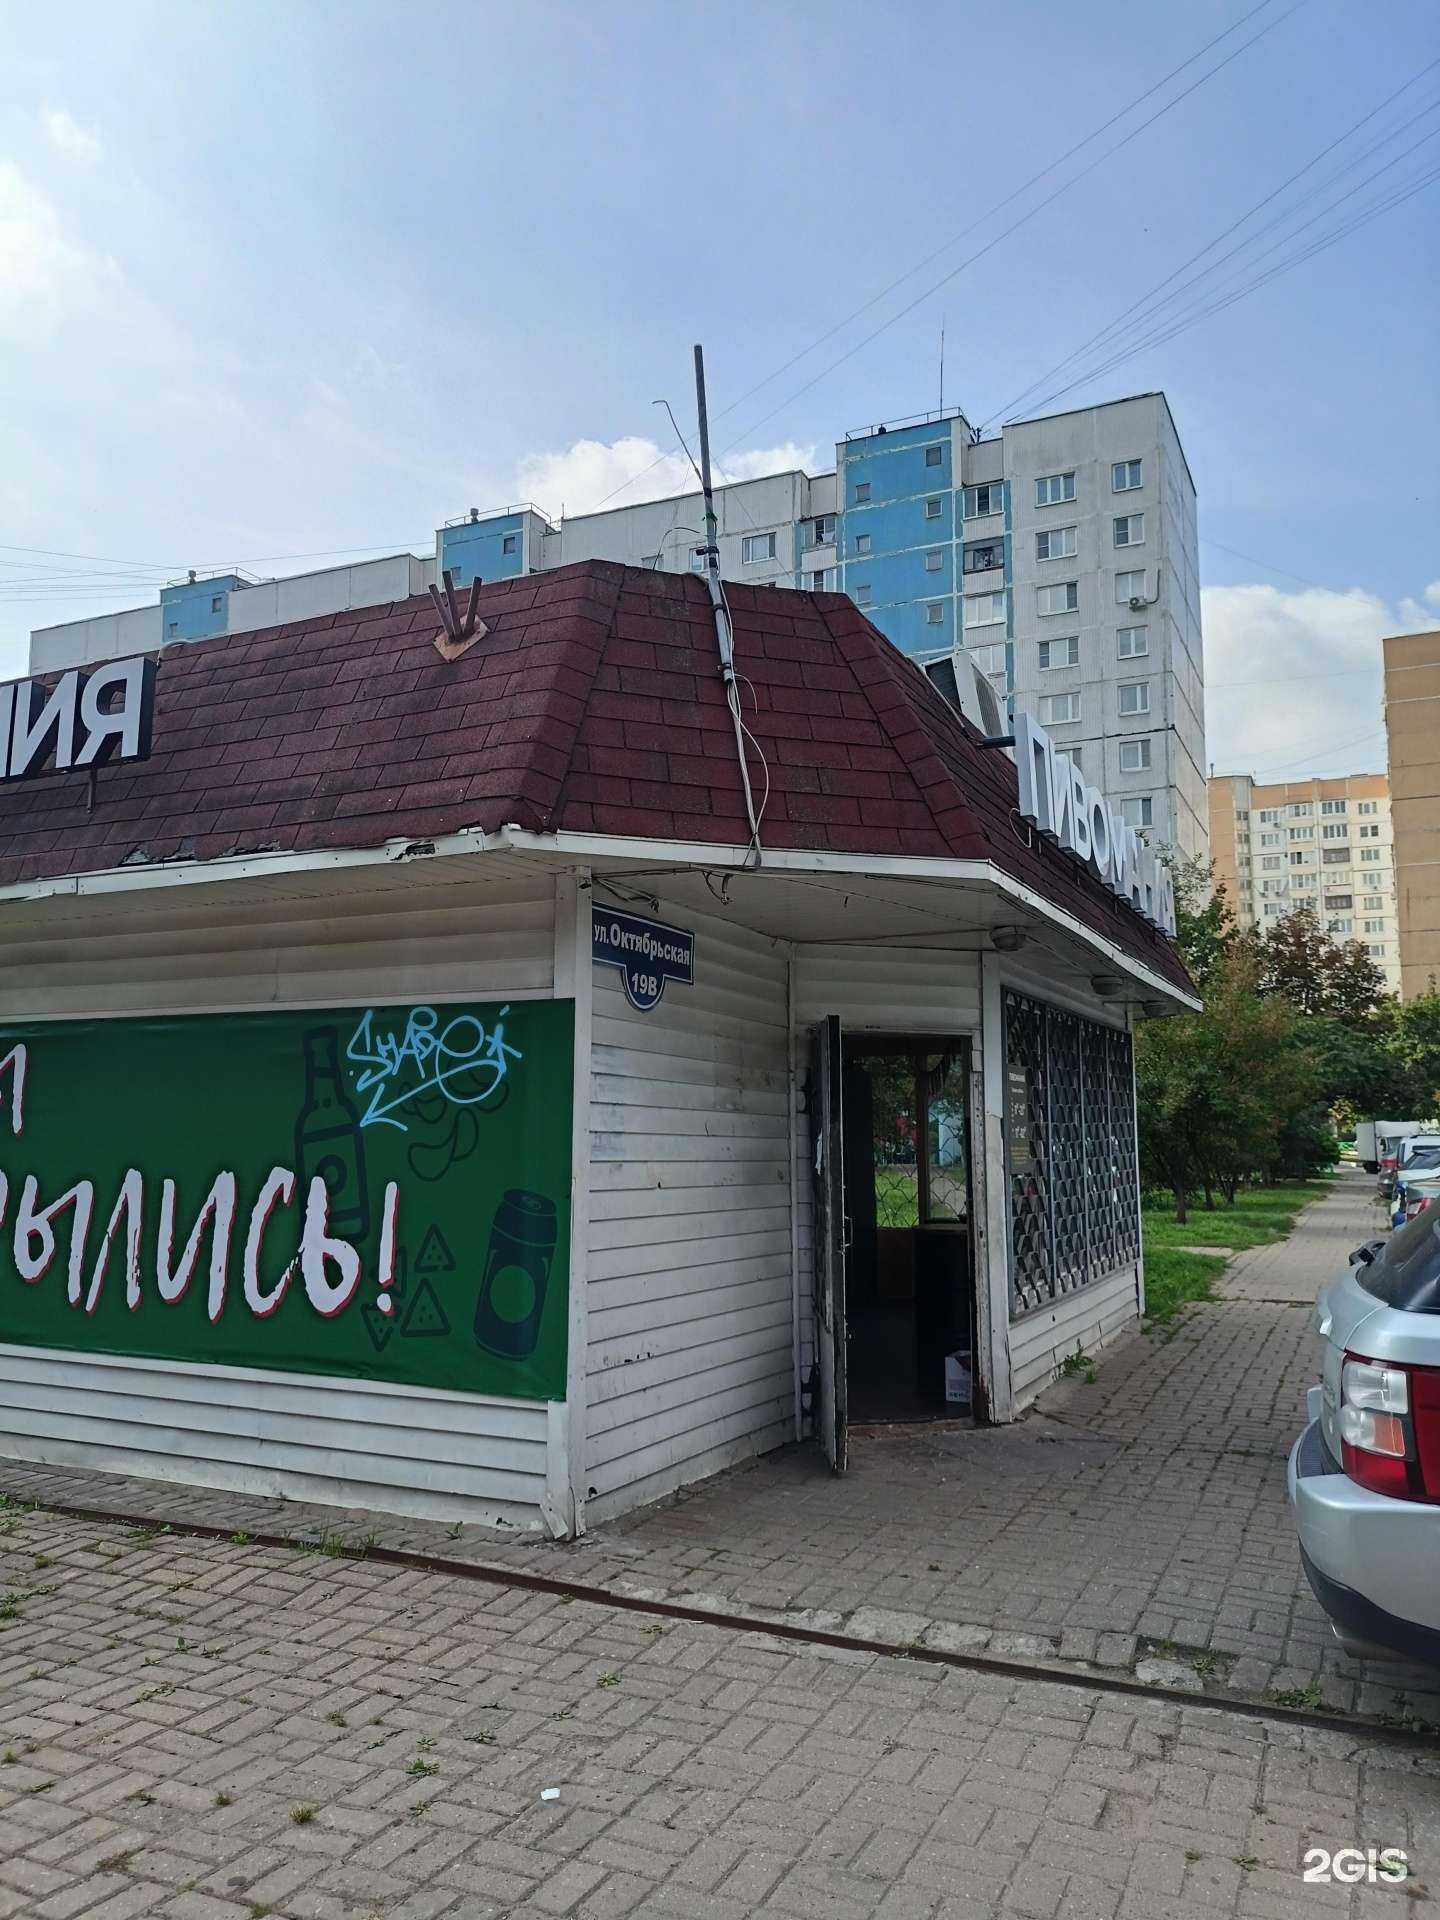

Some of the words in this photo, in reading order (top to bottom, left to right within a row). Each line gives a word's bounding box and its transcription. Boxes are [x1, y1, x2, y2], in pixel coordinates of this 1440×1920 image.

[0, 656, 146, 778] ИЯ
[631, 972, 658, 997] 19В
[0, 1167, 399, 1322] ЫЛИСЬ!
